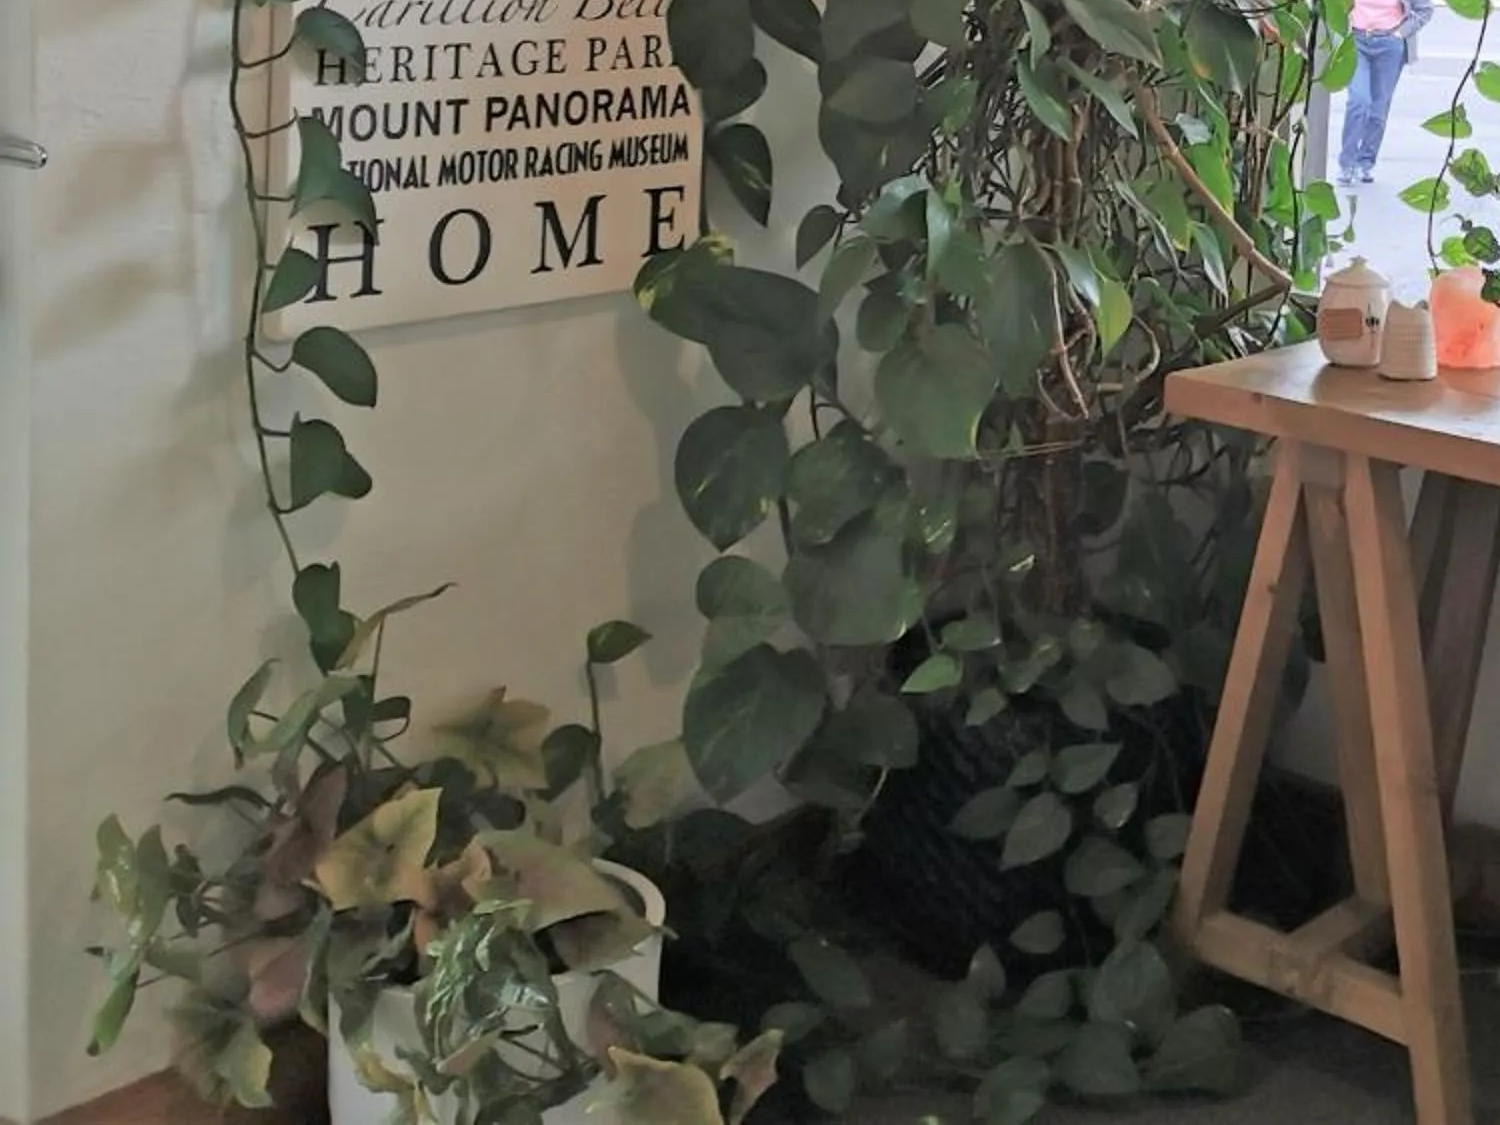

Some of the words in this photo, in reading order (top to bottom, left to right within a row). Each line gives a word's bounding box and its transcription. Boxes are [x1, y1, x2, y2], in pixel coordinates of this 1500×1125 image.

[313, 39, 567, 87] HERITAGE
[584, 33, 679, 71] PAR
[312, 98, 469, 143] MOUNT
[485, 84, 690, 132] PANORAMA
[437, 149, 518, 187] MOTOR
[524, 140, 602, 177] RACING
[608, 133, 689, 167] MUSEUM
[304, 185, 686, 304] HOME
